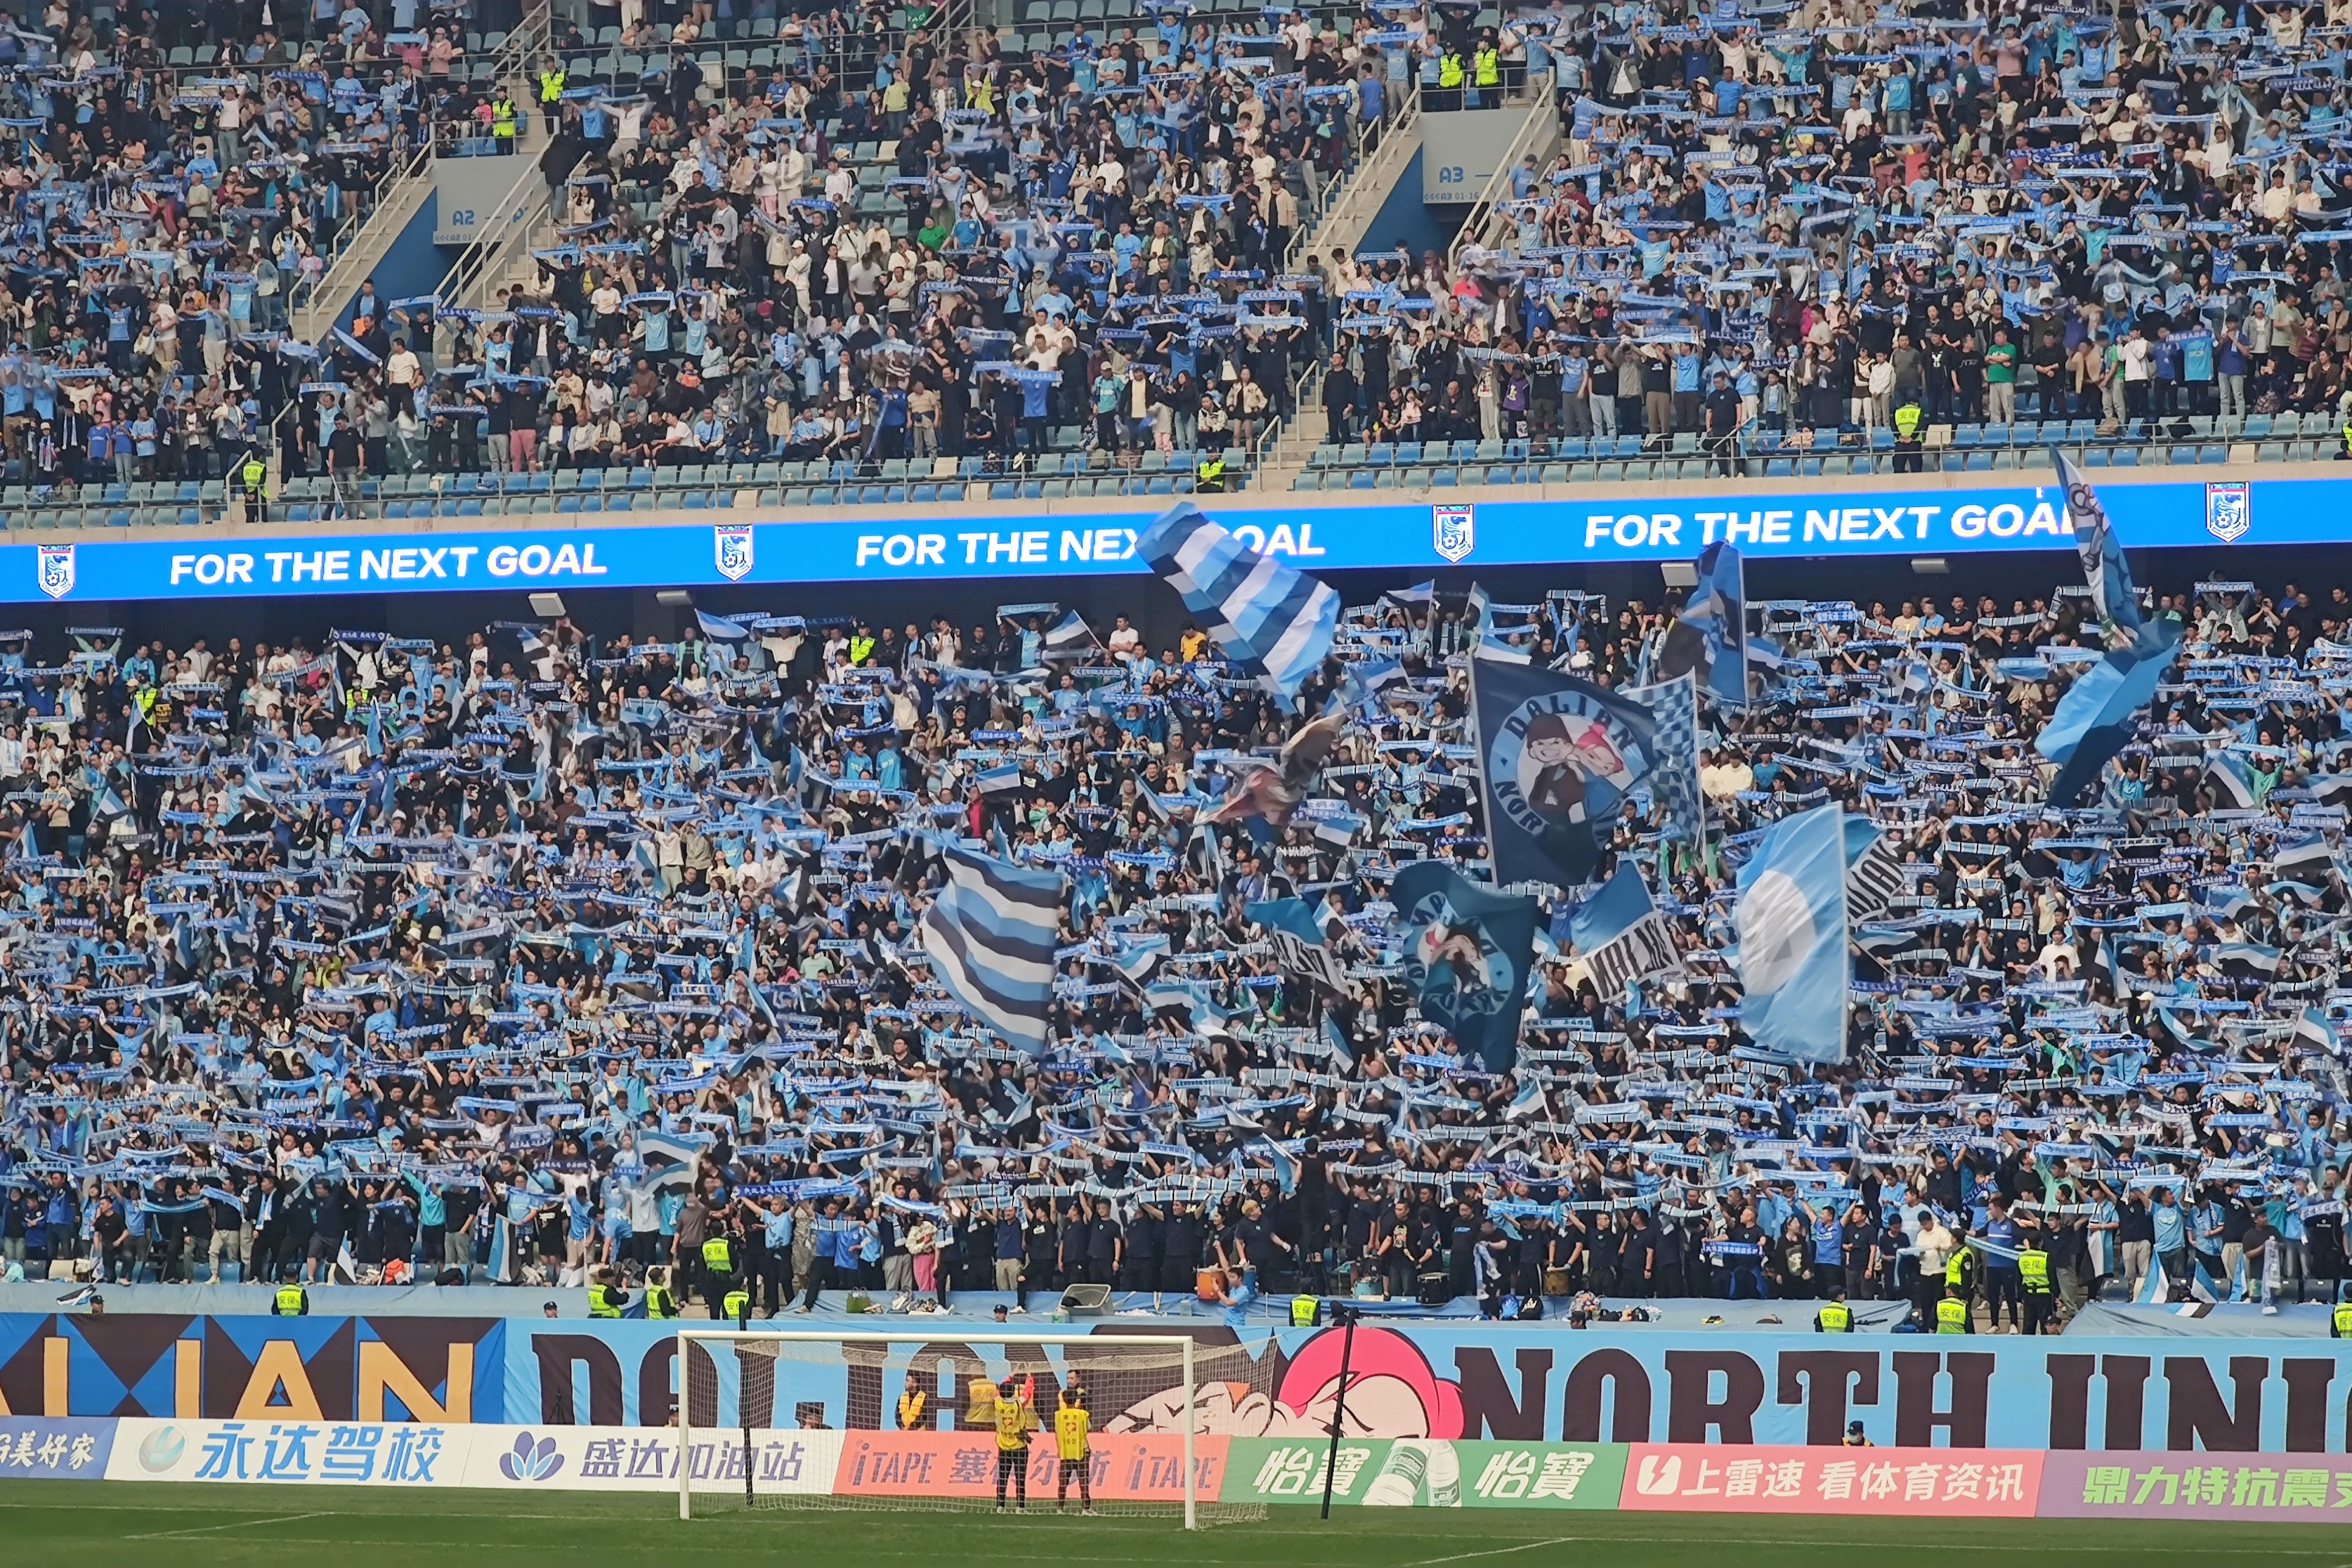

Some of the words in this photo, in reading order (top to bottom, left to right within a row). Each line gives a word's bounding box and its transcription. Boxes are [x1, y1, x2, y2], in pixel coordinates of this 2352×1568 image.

[1439, 166, 1464, 183] A3
[452, 209, 475, 226] A2
[856, 534, 946, 566] FOR
[958, 531, 1049, 563] THE
[1059, 529, 1139, 561] NEX
[1218, 524, 1325, 556] OAL
[1584, 514, 1681, 547] FOR
[1694, 511, 1793, 544] THE
[1803, 507, 1941, 542] NEXT
[171, 554, 254, 584] FOR
[265, 551, 350, 582] THE
[360, 547, 478, 579] NEXT
[487, 544, 607, 576] GOAL
[1822, 1312, 1843, 1324] 安保
[1940, 1307, 1962, 1319] 安保
[1454, 1346, 1996, 1449] NORTH
[195, 1423, 445, 1482] 永达驾校
[580, 1437, 804, 1482] 盛达加油站
[1474, 1449, 1595, 1501] 怡寶
[1681, 1458, 1805, 1498] 上雷速
[1817, 1460, 2024, 1501] 看体育资讯
